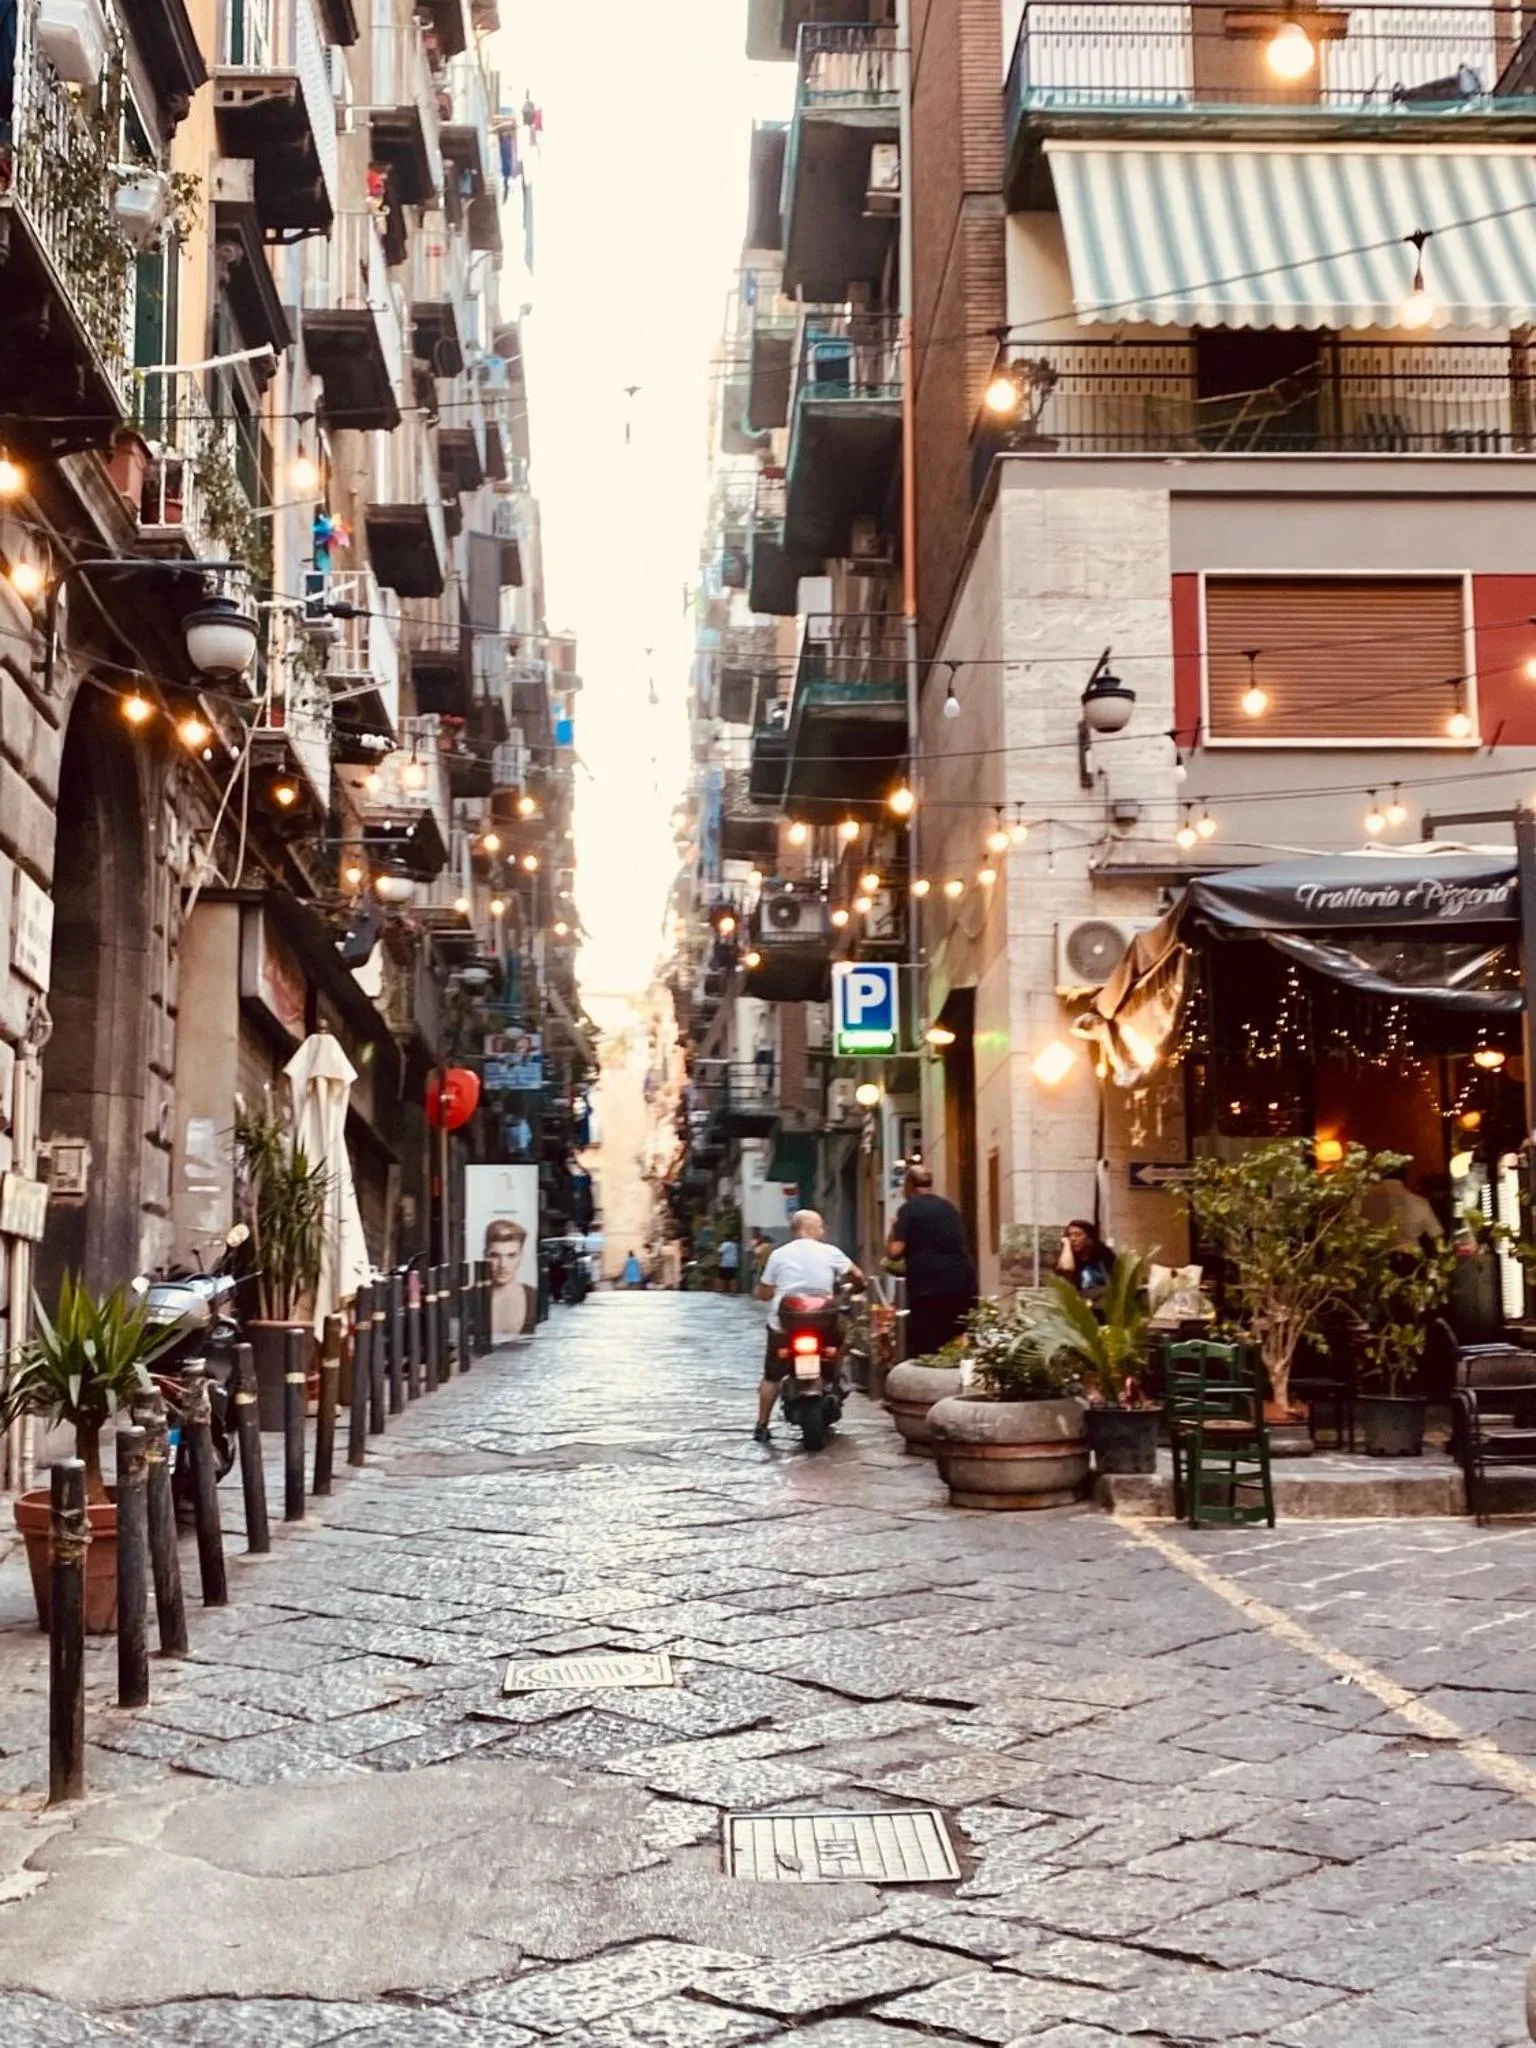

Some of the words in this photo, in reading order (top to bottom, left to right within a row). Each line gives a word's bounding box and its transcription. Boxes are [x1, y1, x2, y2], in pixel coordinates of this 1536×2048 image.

[1294, 882, 1400, 911] Trattoria
[1403, 889, 1418, 907] e
[1417, 878, 1509, 917] Pizzeria
[846, 973, 887, 1024] P
